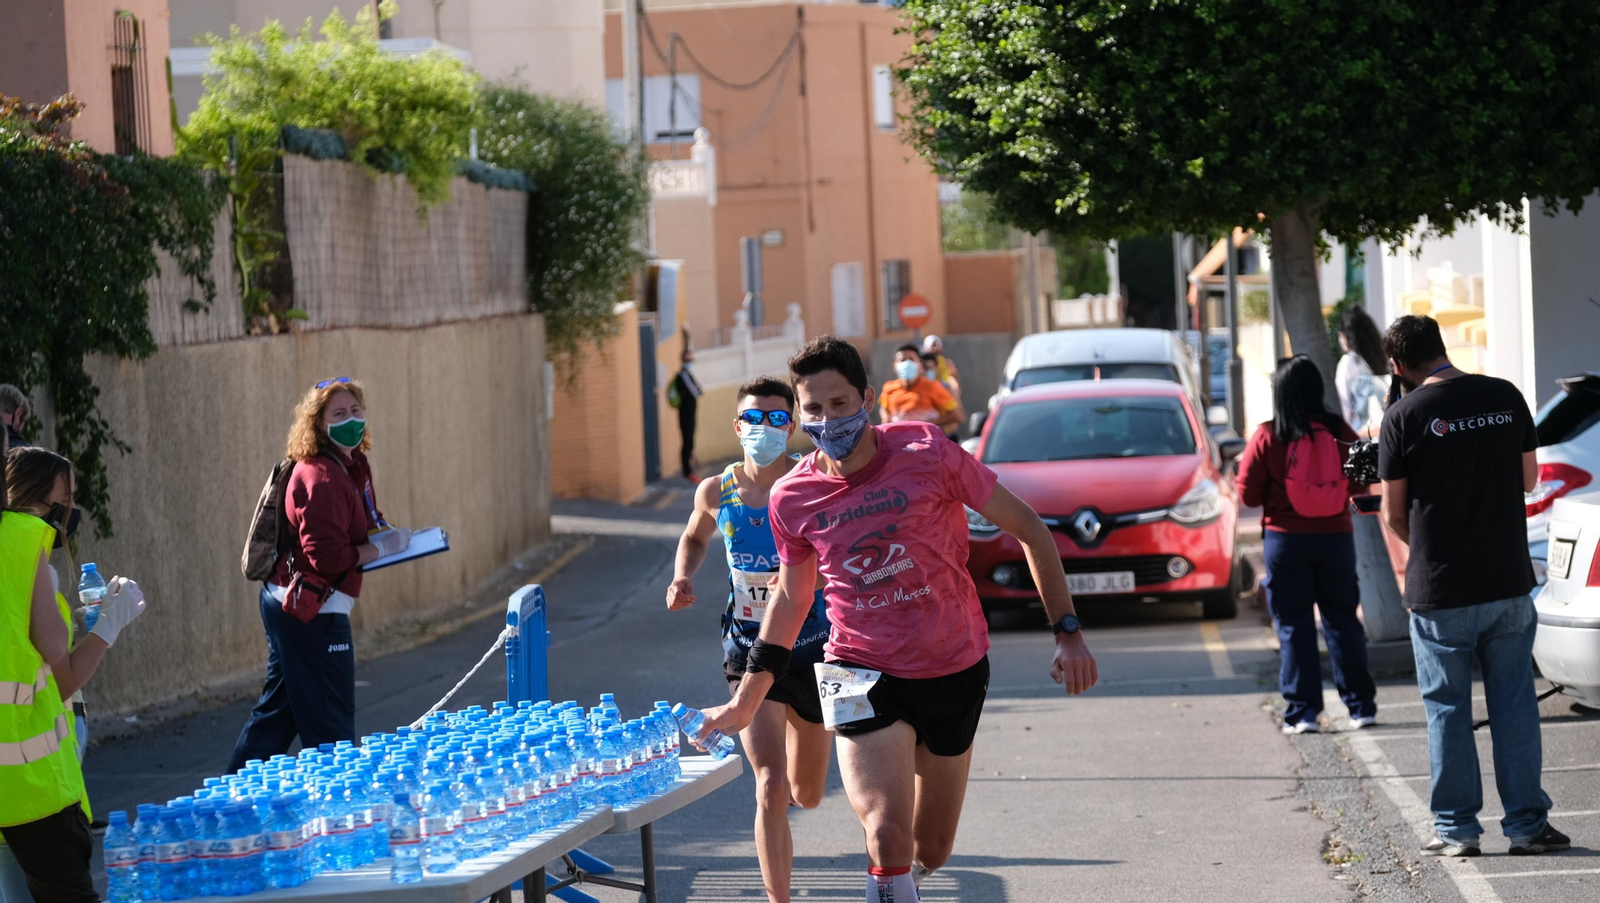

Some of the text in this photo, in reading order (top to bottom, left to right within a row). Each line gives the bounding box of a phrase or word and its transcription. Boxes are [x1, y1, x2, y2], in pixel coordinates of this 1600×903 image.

[1449, 415, 1513, 432] RECDRON
[863, 489, 888, 502] Club
[861, 558, 914, 585] CARBONERAS
[1067, 575, 1096, 591] 380
[856, 585, 931, 610] A Cal Marcos
[794, 629, 829, 649] pasur.es
[820, 680, 842, 698] 63
